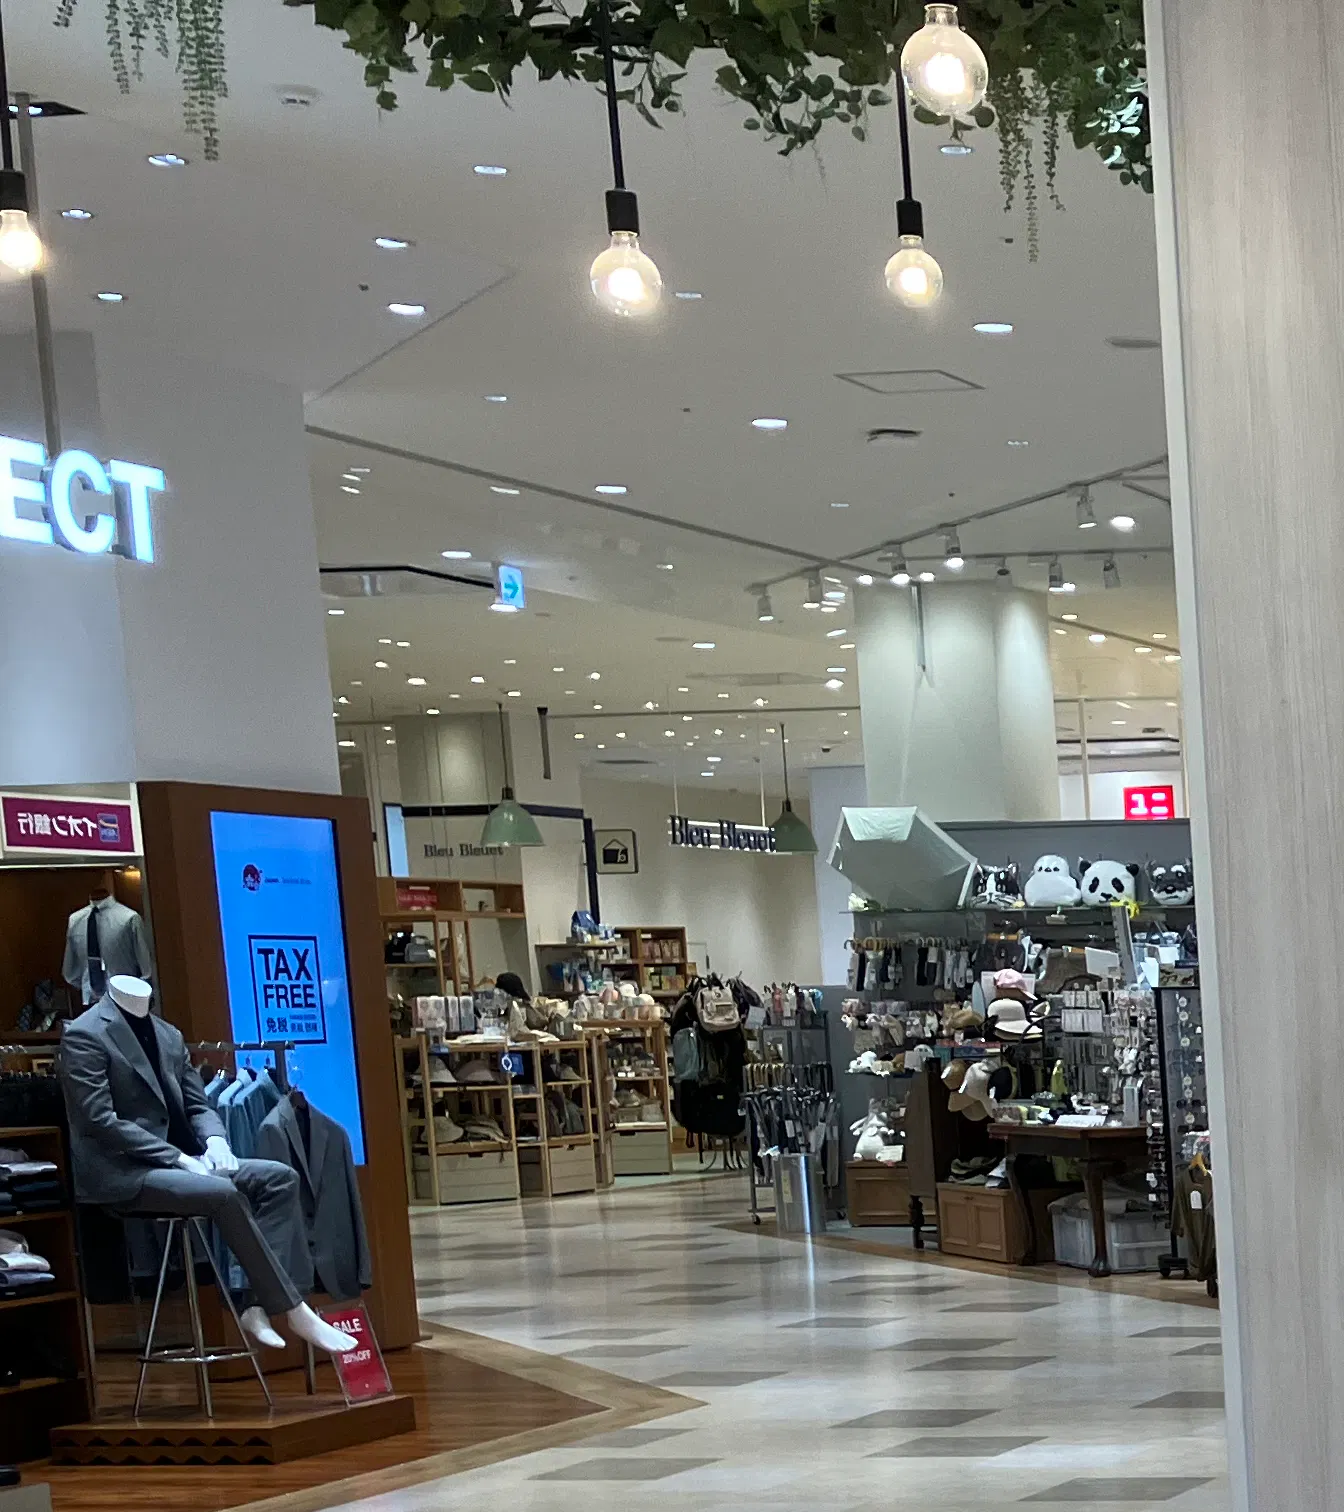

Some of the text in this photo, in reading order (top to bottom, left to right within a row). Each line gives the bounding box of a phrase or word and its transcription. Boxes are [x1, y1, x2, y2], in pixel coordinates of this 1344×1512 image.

[669, 814, 711, 847] Bleu
[423, 843, 505, 858] Bleu Bleuet
[256, 947, 314, 981] TAX
[262, 983, 317, 1009] FREE
[332, 1317, 362, 1334] SALE
